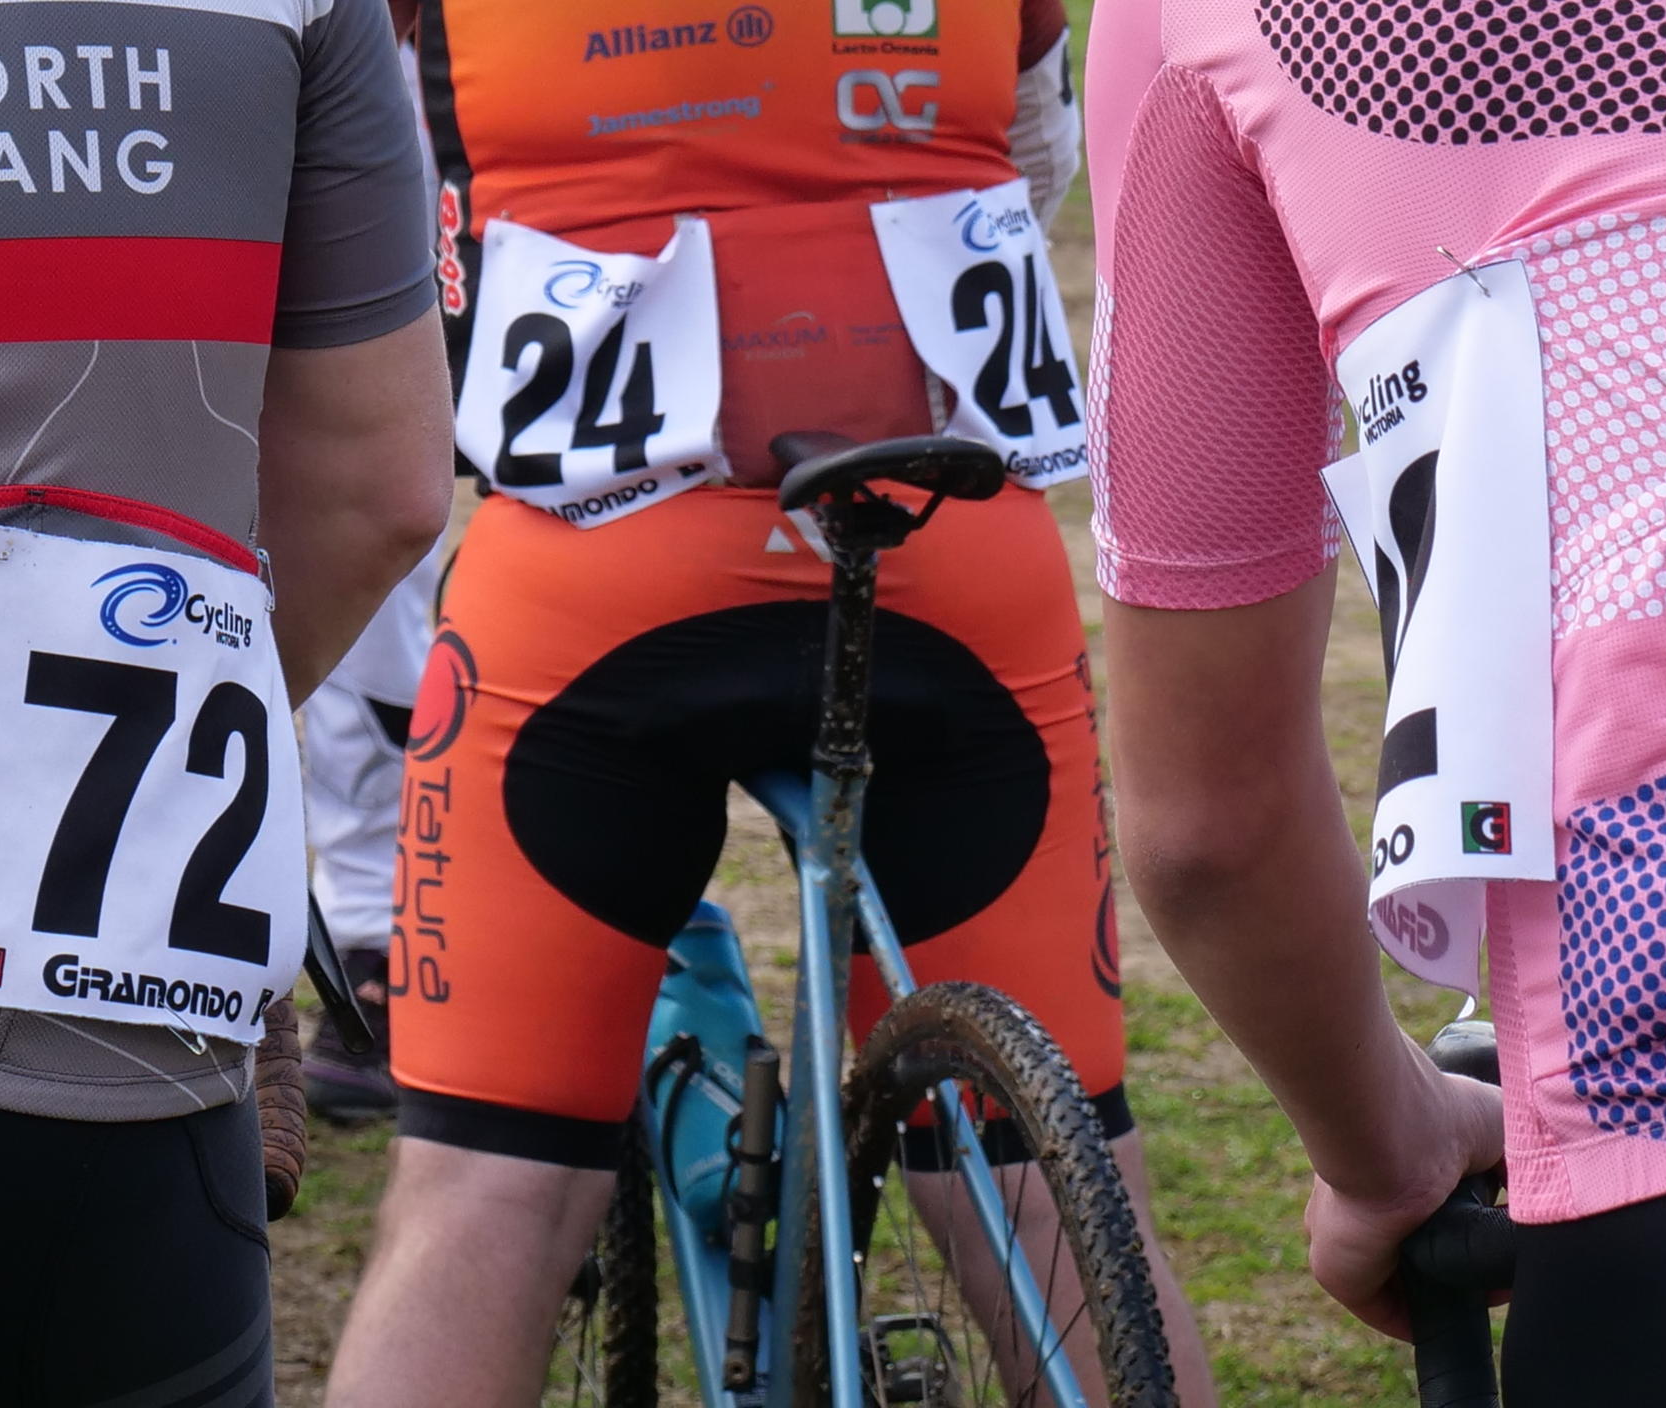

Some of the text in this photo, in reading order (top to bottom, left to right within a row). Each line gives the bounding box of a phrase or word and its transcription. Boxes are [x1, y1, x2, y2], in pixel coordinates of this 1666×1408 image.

[583, 20, 717, 62] Allianz
[587, 95, 762, 137] Jamestrong
[494, 311, 666, 488] 24
[950, 253, 1082, 439] 24
[184, 593, 253, 648] Cycling
[24, 649, 272, 967] 72
[415, 766, 452, 1004] Tatura
